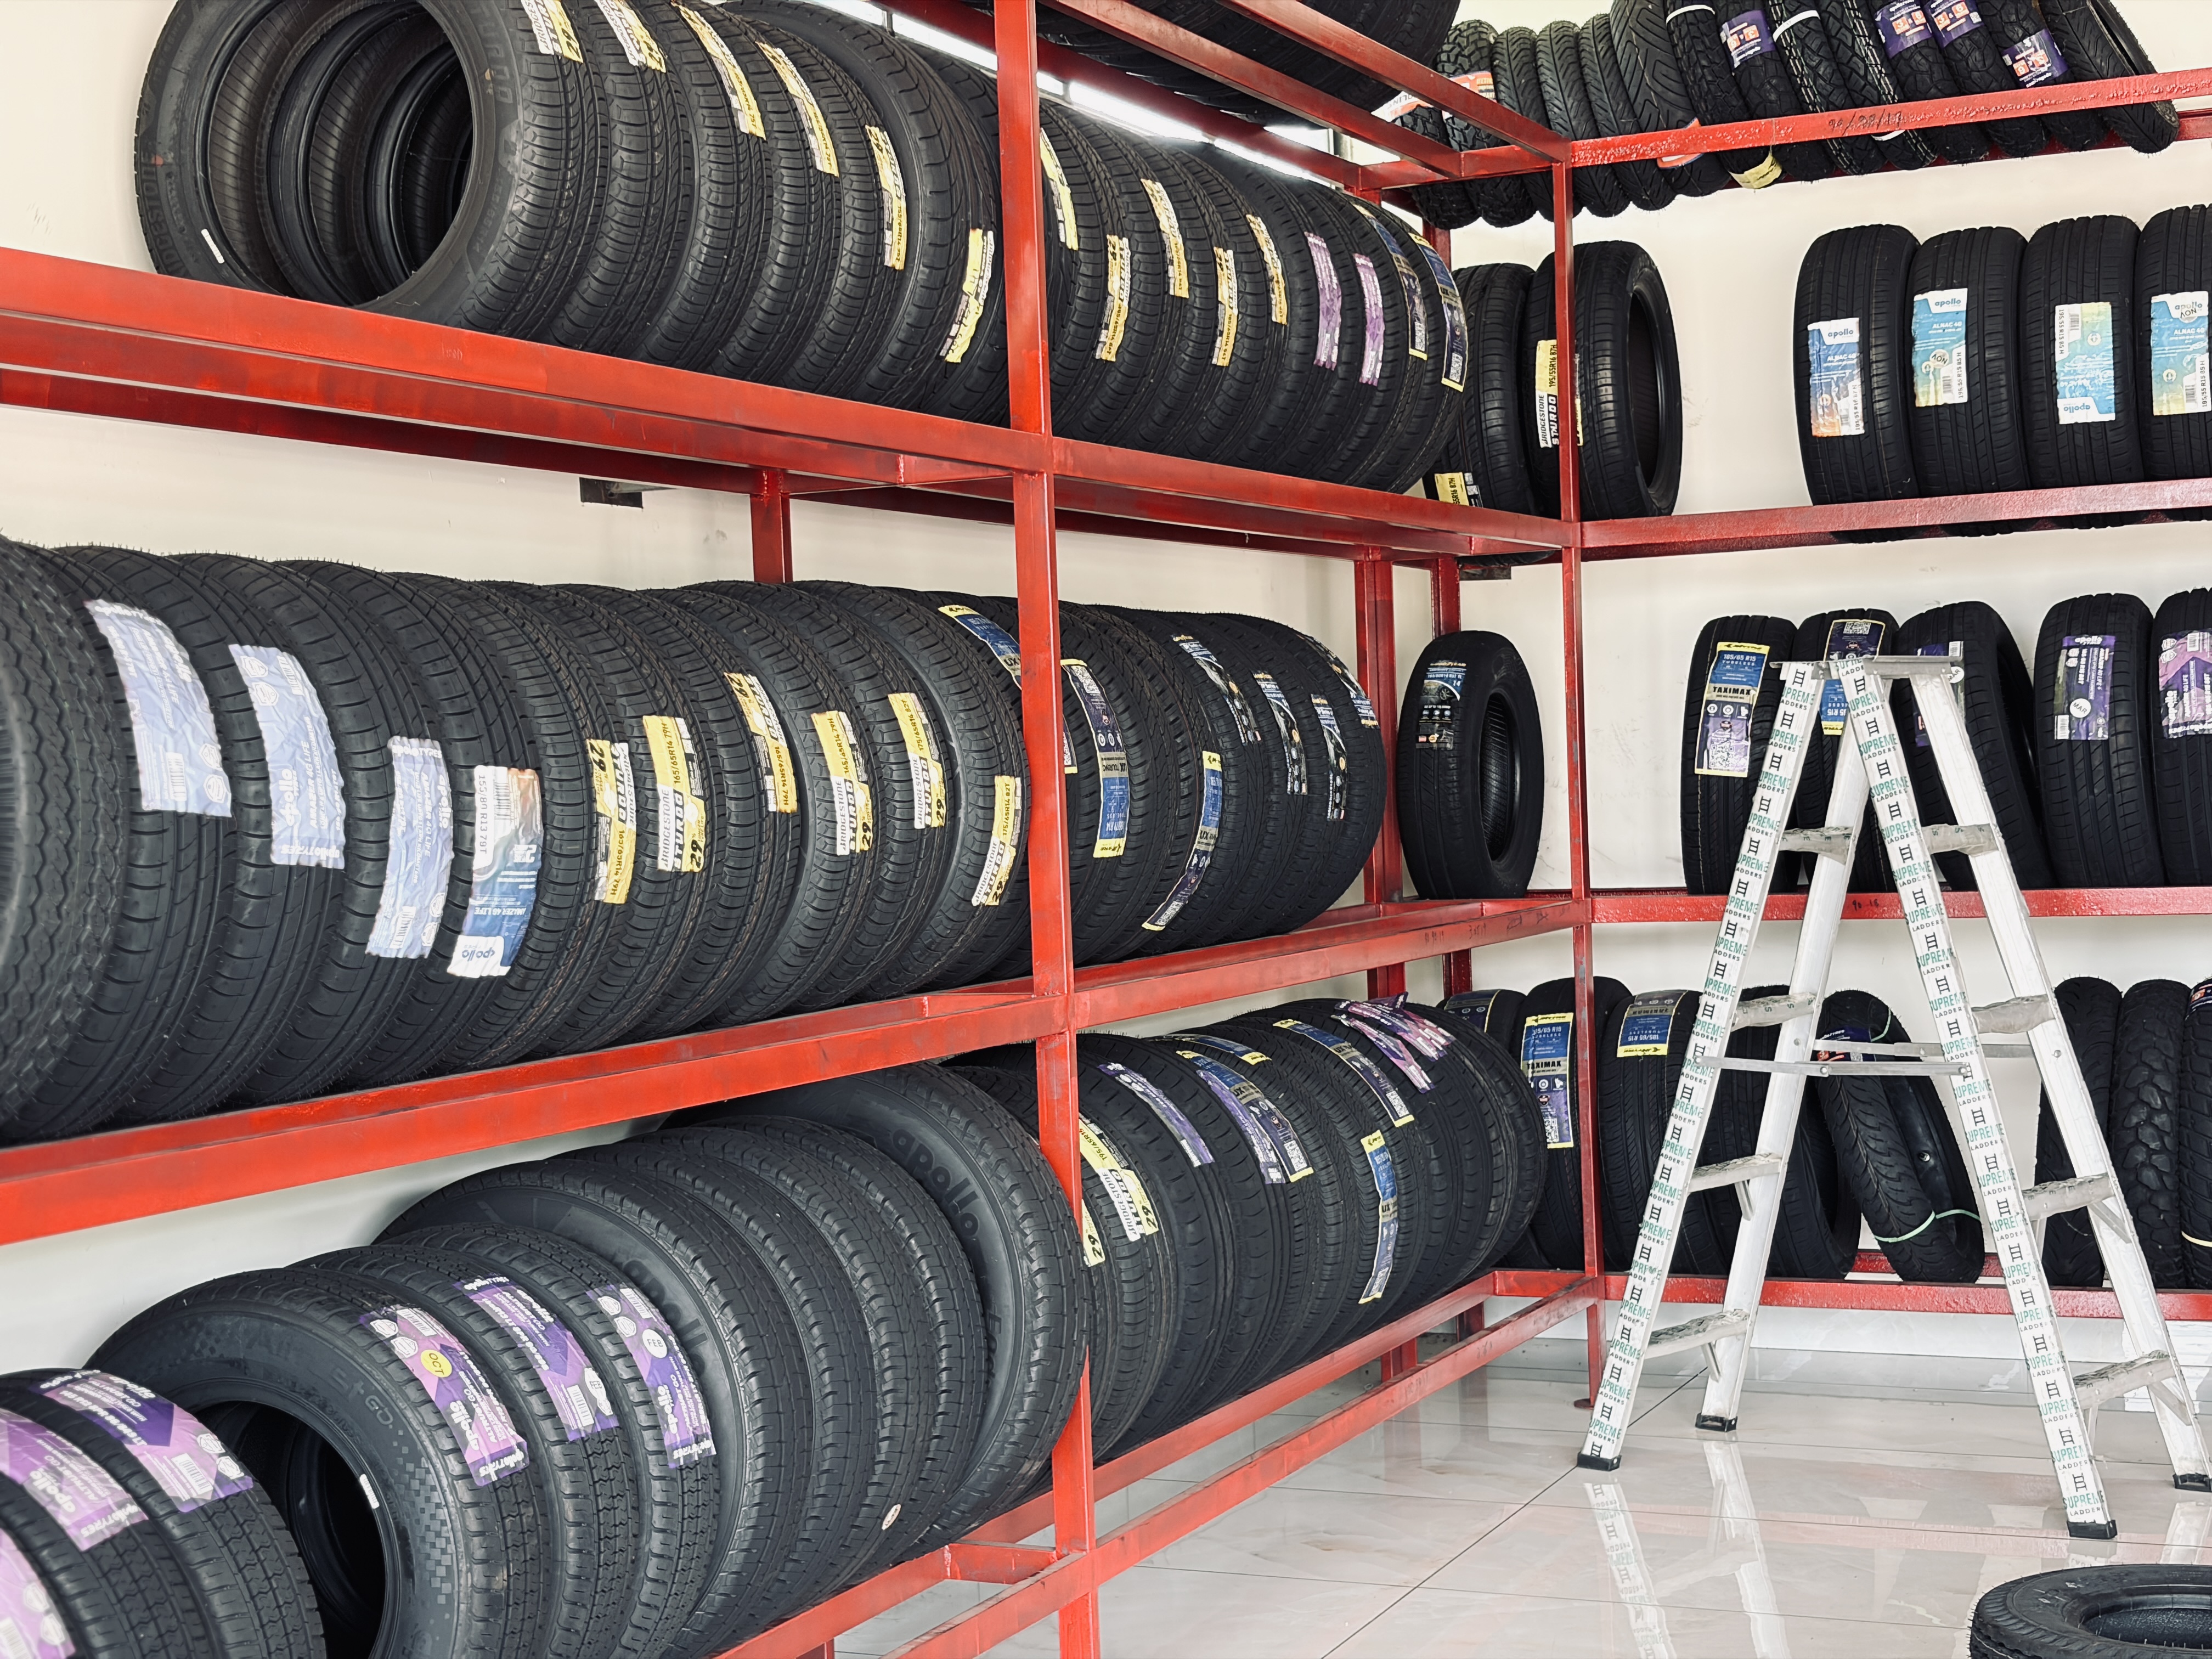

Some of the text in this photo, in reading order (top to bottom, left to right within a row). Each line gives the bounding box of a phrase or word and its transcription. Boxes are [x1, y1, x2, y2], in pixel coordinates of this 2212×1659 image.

[1934, 298, 1962, 308] apollo
[2175, 301, 2203, 312] apollo
[1827, 329, 1853, 338] apollo
[2063, 404, 2091, 414] apollo
[1538, 393, 1550, 448] BRIDGESTONE
[1948, 668, 1961, 681] MAR
[725, 675, 749, 699] 29
[1712, 686, 1751, 696] TAXIMAX
[2072, 702, 2087, 714] MAR
[902, 699, 924, 752] 175/65R14 82T
[301, 740, 311, 760] LIFE
[662, 723, 681, 785] 165/65R14 79H
[828, 718, 850, 774] 165/65R14 79H
[1768, 741, 1796, 752] ADDERS
[1859, 734, 1898, 755] SUPREME
[1865, 746, 1896, 760] LADDERS
[589, 742, 607, 772] 29
[774, 746, 789, 806] 165/65R14 79H
[421, 771, 433, 821] AMAZER
[910, 756, 923, 825] BRIDGESTONE
[1870, 776, 1909, 798] SUPREME
[1876, 788, 1909, 802] LADDERS
[308, 776, 319, 829] AMAZER
[437, 774, 448, 829] apollo
[936, 798, 945, 824] 29
[478, 775, 488, 855] 155/80 R13 79T
[836, 780, 847, 851] BRIDGESTONE
[660, 788, 670, 868] BRIDGESTONE
[673, 792, 684, 871] STURDO
[861, 822, 872, 848] 29
[1746, 826, 1773, 837] ADDERS
[424, 838, 432, 858] LIFE
[528, 844, 537, 863] 2
[690, 839, 702, 870] 29
[974, 840, 1000, 902] BRIDGESTONE
[1735, 867, 1762, 878] ADDERS
[992, 879, 1003, 904] 29
[474, 907, 493, 915] LIFE
[1725, 909, 1751, 920] ADDERS
[1912, 919, 1944, 932] LADDERS
[1714, 950, 1740, 961] ADDERS
[1922, 963, 1950, 975] LADDER
[1704, 990, 1729, 1002] ADDERS
[1935, 1006, 1962, 1018] LADDER
[1691, 1030, 1718, 1042] ADDERS
[1946, 1049, 1978, 1062] LADDERS
[1681, 1072, 1707, 1085] ADDERS
[1660, 1153, 1684, 1165] ADDERS
[892, 1128, 980, 1237] apollo
[1100, 1170, 1138, 1241] BRIDGESTONE
[1649, 1192, 1674, 1206] ADDERS
[1140, 1204, 1156, 1229] 29
[1087, 1233, 1103, 1261] 29
[1639, 1232, 1664, 1245] ADDERS
[646, 1339, 663, 1348] FEB
[428, 1352, 444, 1376] OCT
[1610, 1352, 1634, 1365] ADDERS
[110, 1375, 156, 1399] apollo
[1599, 1391, 1624, 1404] ADDERS
[657, 1385, 678, 1435] apollo
[449, 1401, 481, 1452] apollo
[1589, 1430, 1615, 1444] ADDERS
[30, 1470, 76, 1513] apollo
[55, 1464, 99, 1502] ALTRUST
[2070, 1508, 2101, 1516] LADDER
